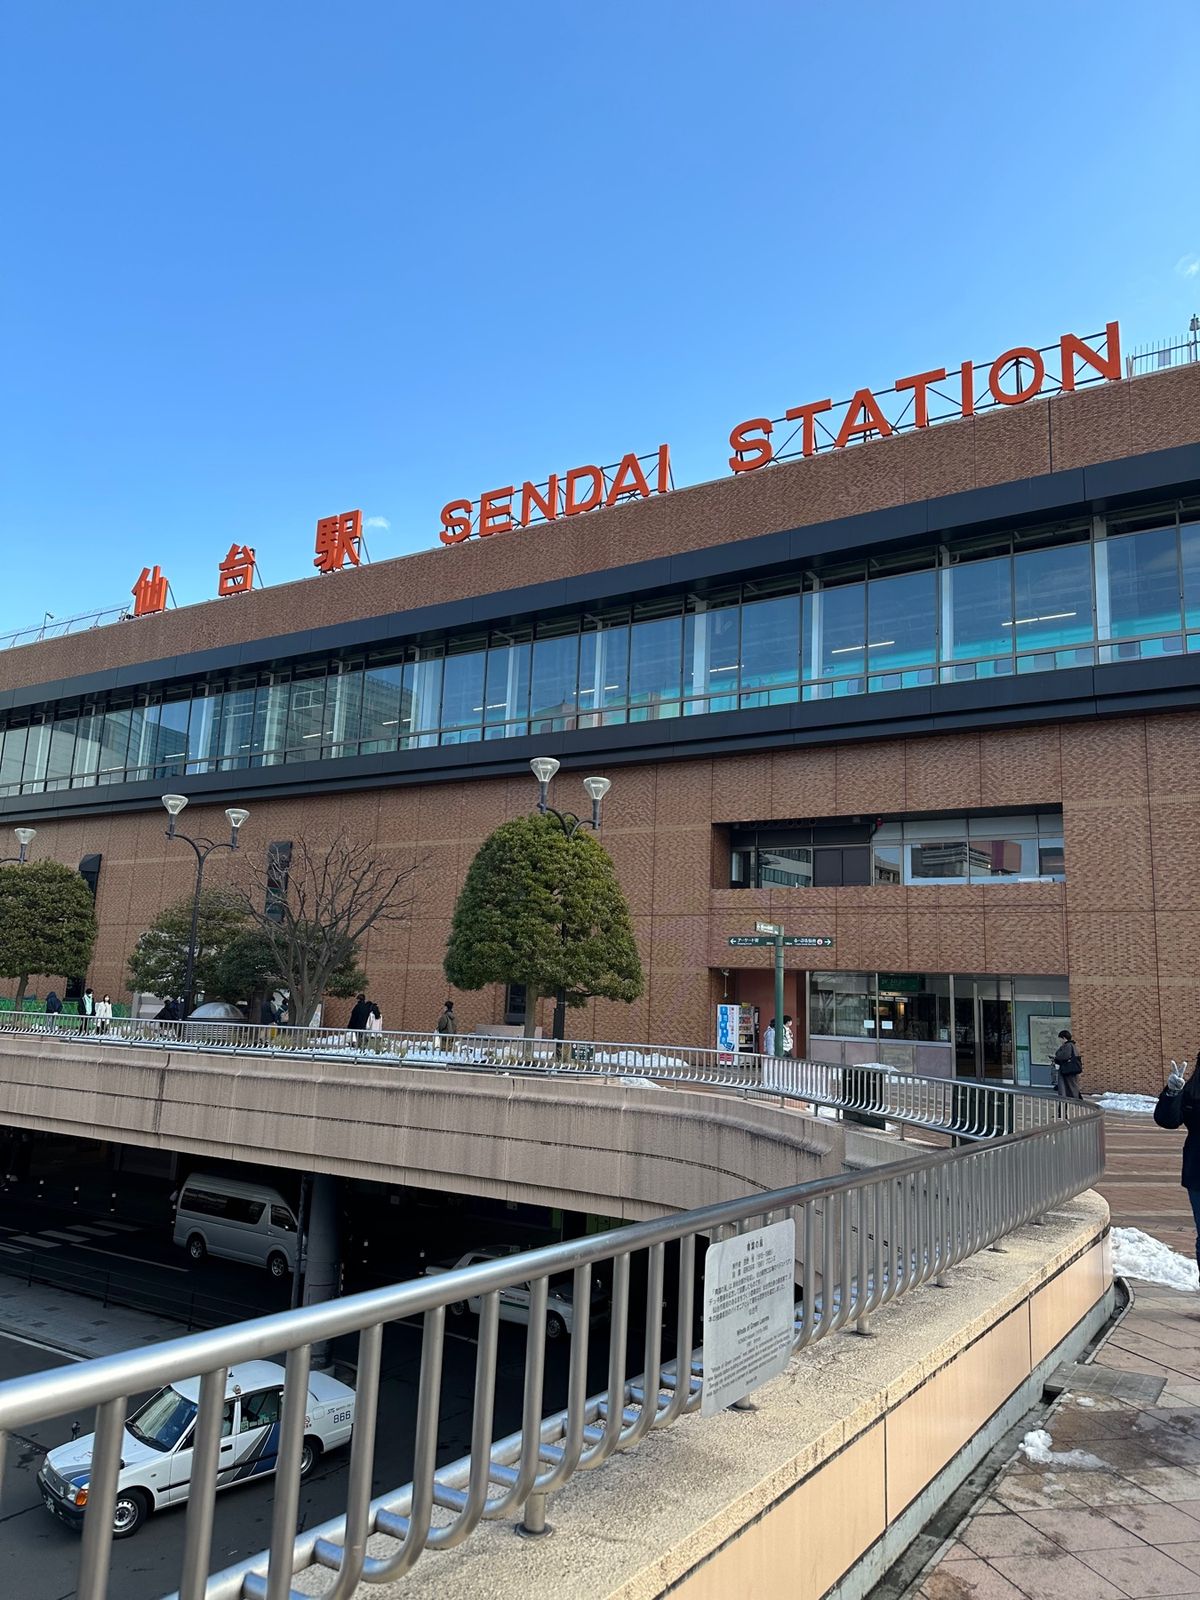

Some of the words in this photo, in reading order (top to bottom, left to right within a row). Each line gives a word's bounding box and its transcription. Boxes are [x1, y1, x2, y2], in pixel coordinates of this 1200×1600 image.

[440, 445, 669, 545] SENDAI
[730, 322, 1121, 472] STATION
[132, 510, 362, 616] 仙台駅
[333, 1411, 351, 1424] 866
